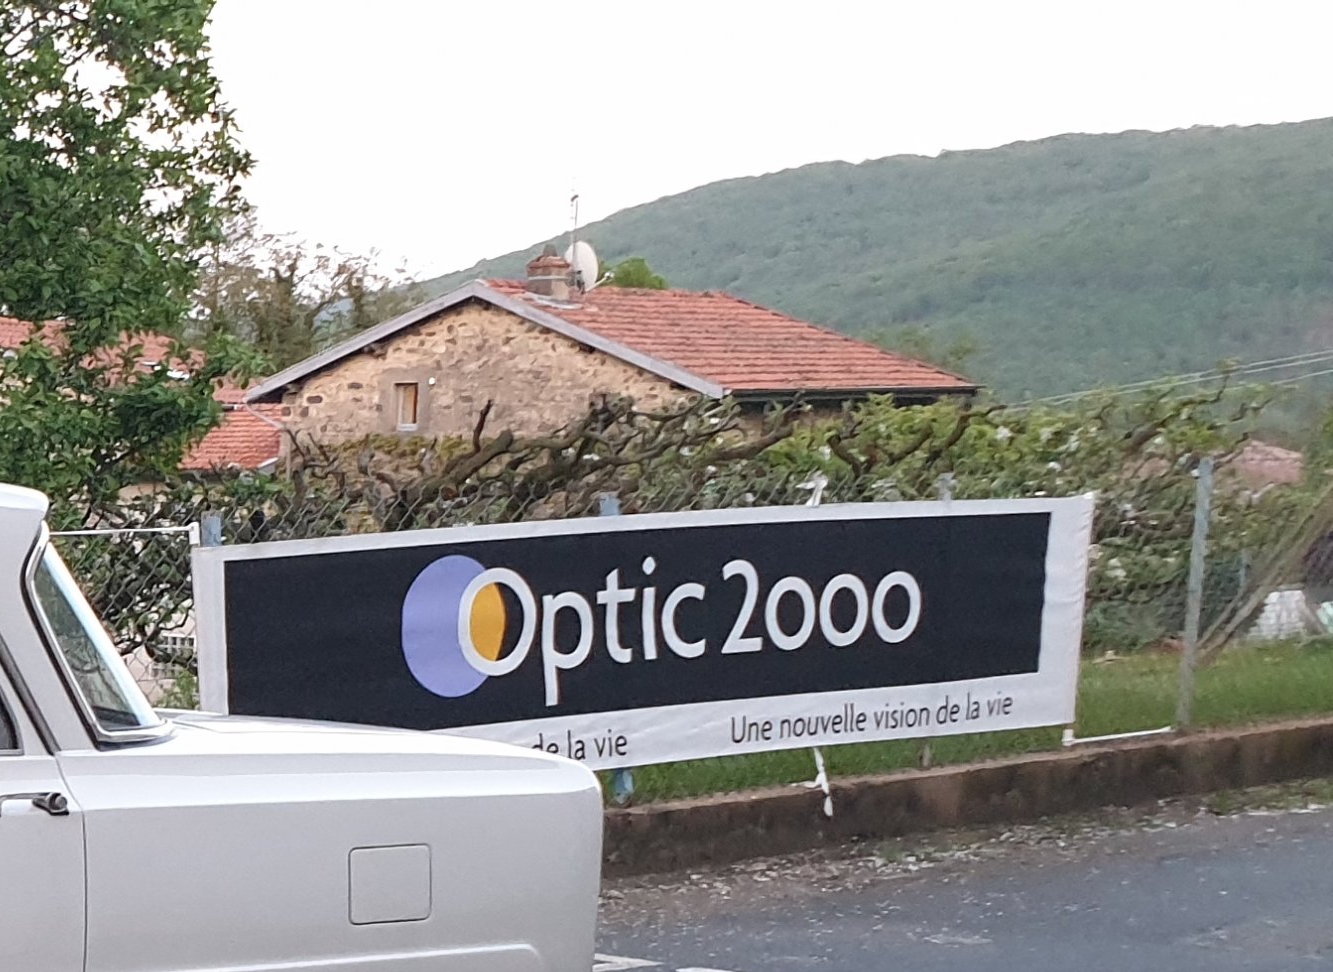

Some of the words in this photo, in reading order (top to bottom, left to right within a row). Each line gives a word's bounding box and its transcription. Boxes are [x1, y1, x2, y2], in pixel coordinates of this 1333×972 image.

[458, 556, 706, 706] Optic
[721, 560, 923, 654] 2000
[731, 715, 773, 744] Une
[779, 702, 867, 739] nouvelle
[873, 701, 931, 730] vision
[935, 694, 961, 725] de
[966, 692, 980, 721] la
[986, 690, 1013, 716] vie
[567, 730, 586, 760] la
[594, 729, 628, 757] vie
